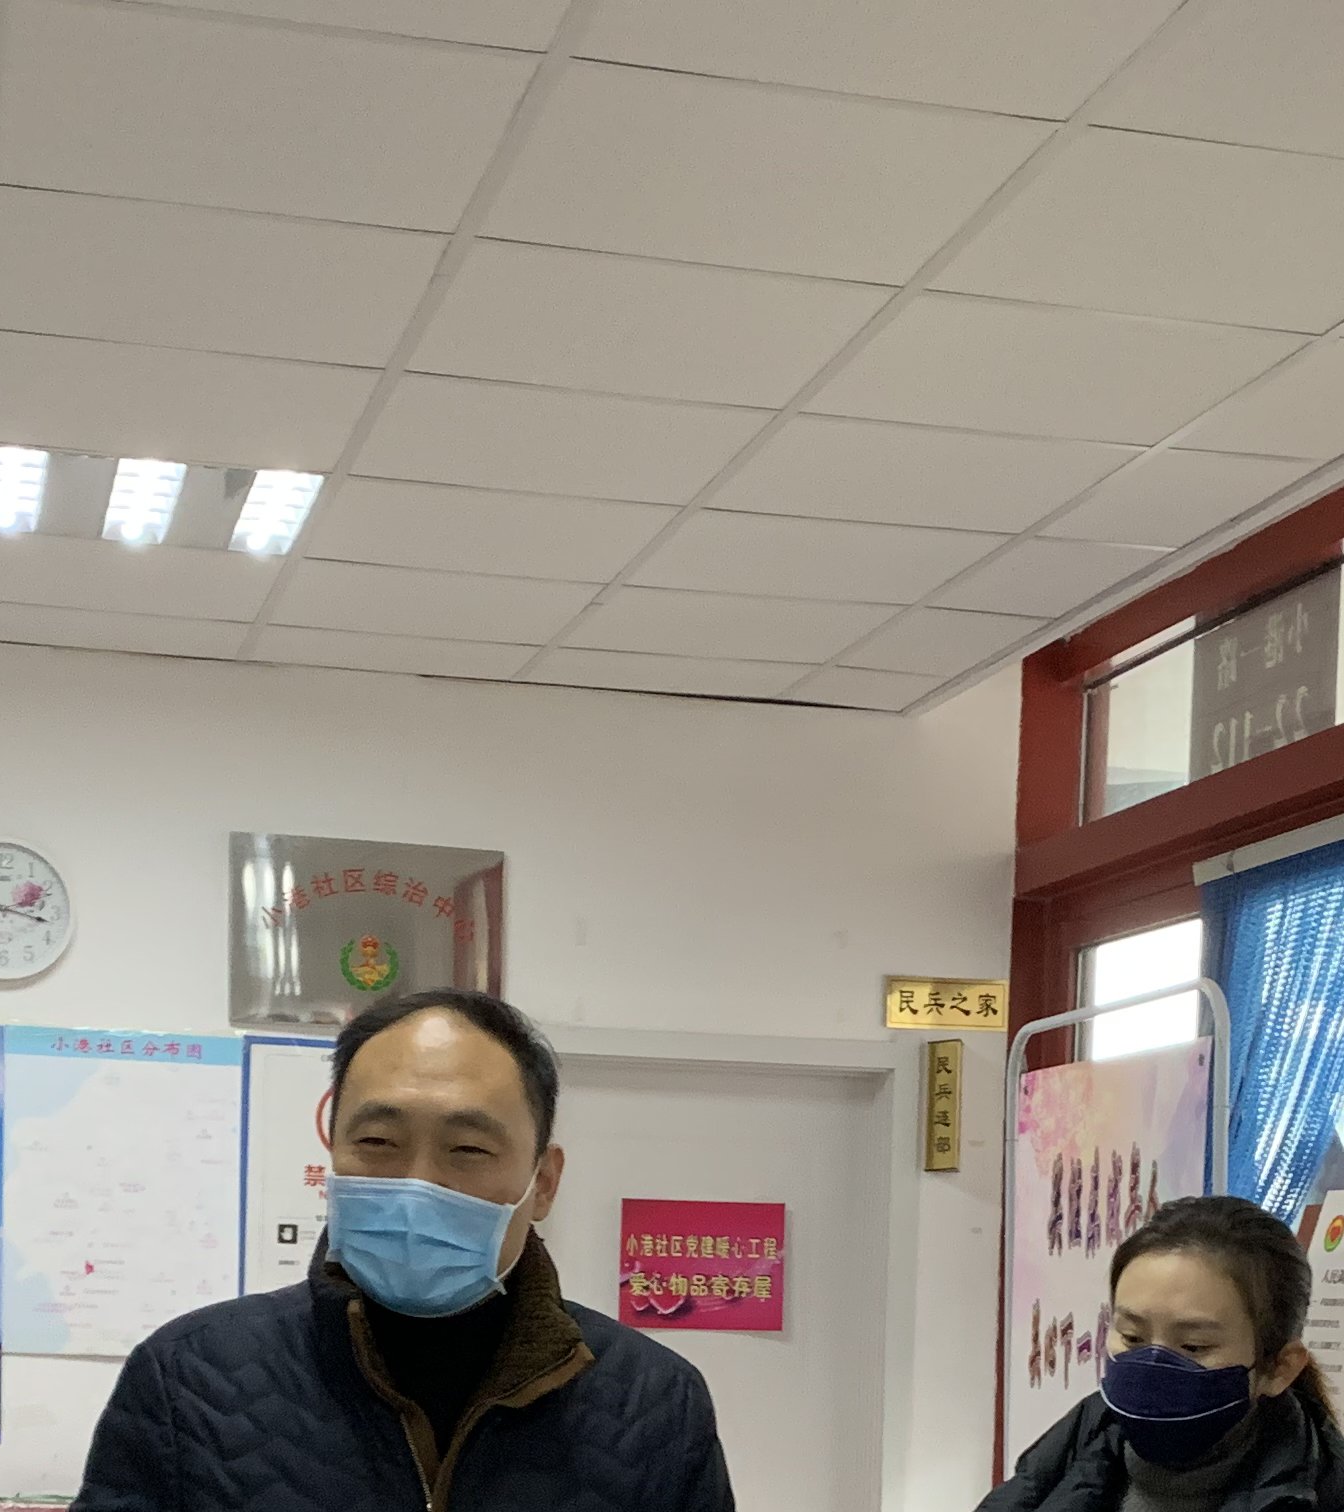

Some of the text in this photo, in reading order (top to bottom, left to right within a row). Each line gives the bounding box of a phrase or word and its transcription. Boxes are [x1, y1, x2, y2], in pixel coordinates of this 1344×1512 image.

[898, 990, 999, 1017] 民兵之家
[51, 1036, 203, 1060] 小港社区分布图
[625, 1233, 778, 1260] 小港社区党建暖心工程
[628, 1272, 773, 1299] 爱心物品寄存屋
